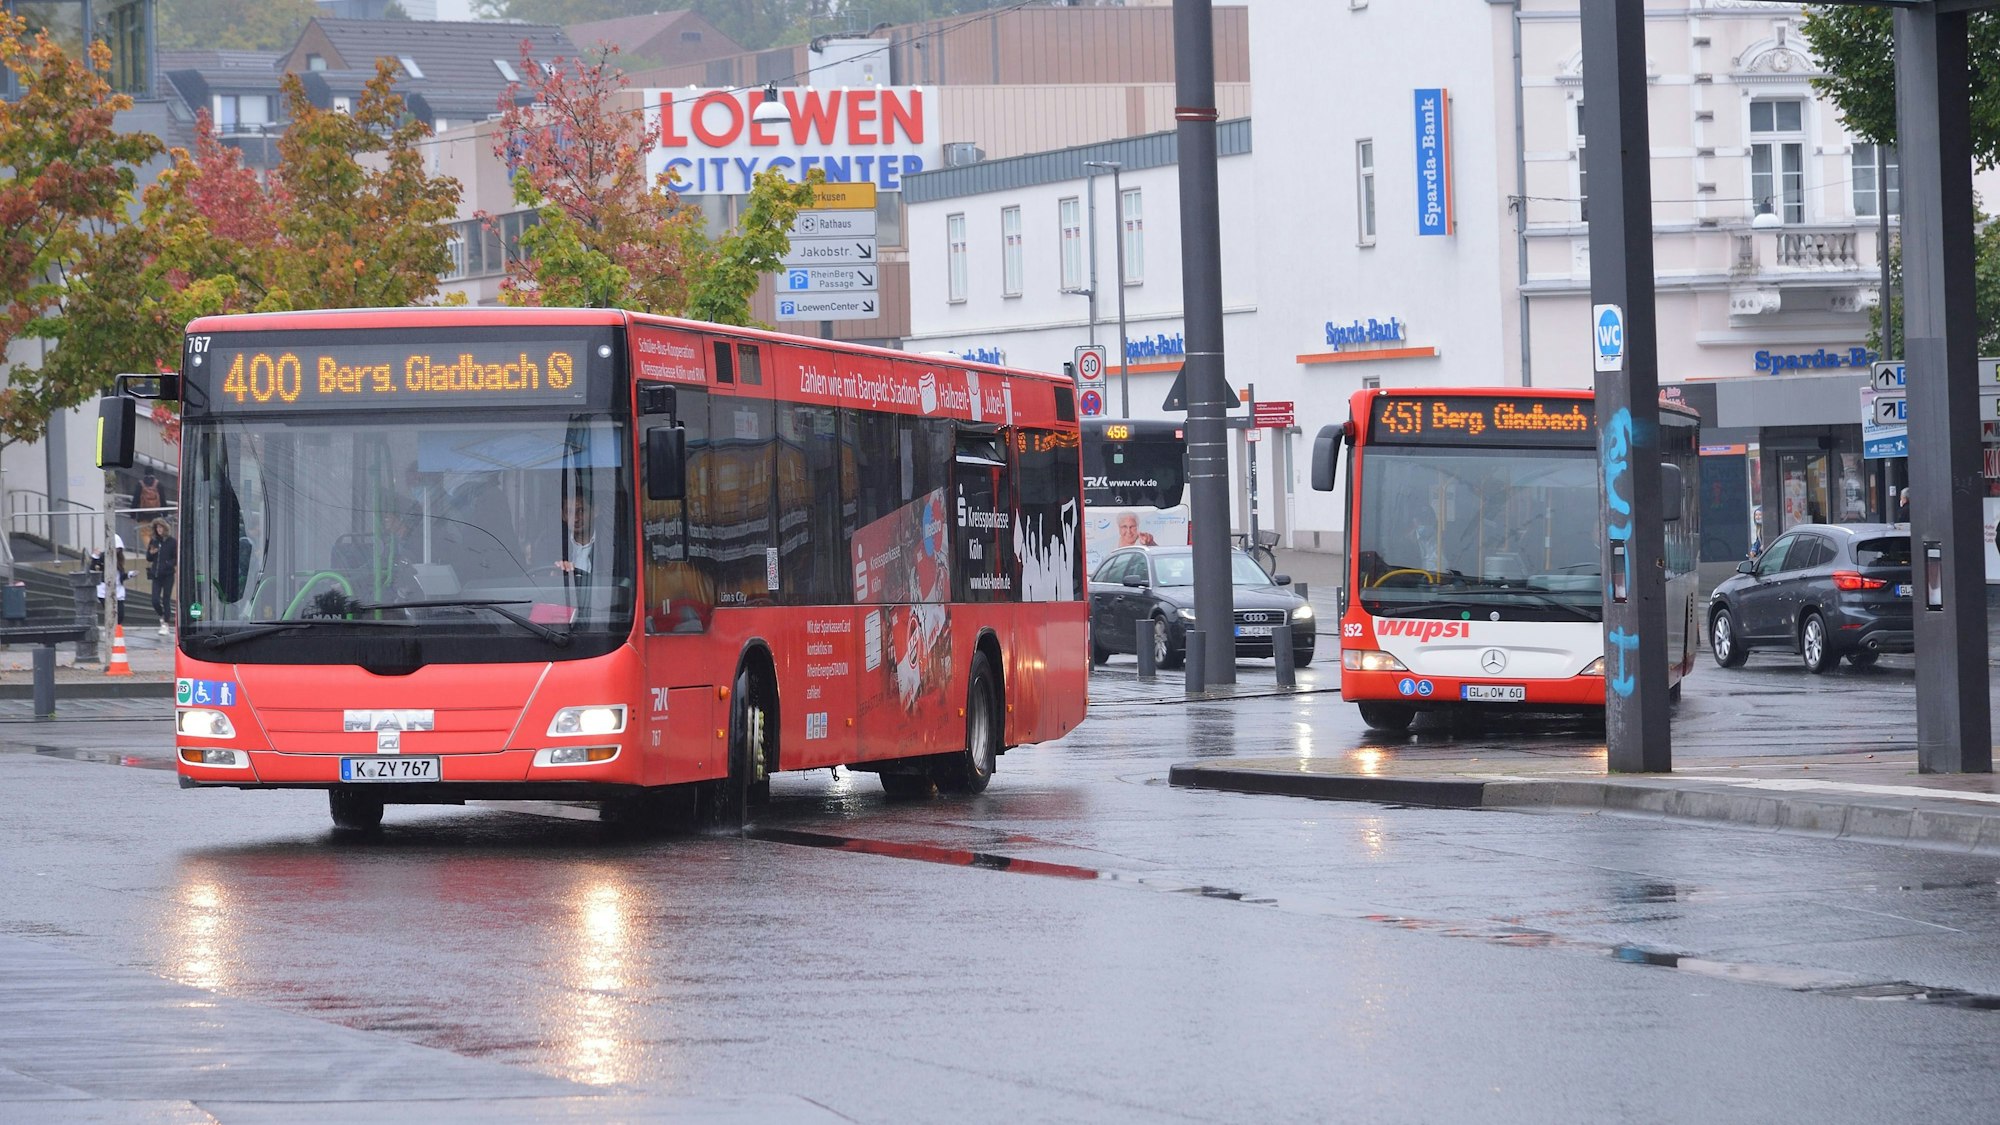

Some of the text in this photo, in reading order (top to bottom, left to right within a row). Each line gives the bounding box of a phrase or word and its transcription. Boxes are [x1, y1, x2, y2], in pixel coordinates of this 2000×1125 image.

[660, 90, 924, 147] LOEWEN
[1421, 98, 1442, 226] Sparda-Bank
[813, 192, 846, 202] erkusen
[820, 219, 852, 229] Rathaus
[800, 247, 853, 257] Jakobstr.
[811, 270, 854, 279] RheinBerg
[820, 280, 854, 289] Passage
[797, 302, 859, 312] LoewenCenter
[1325, 316, 1401, 351] Sparda-Bank
[1599, 325, 1620, 346] WC
[187, 336, 211, 354] 767
[638, 337, 695, 360] Schüler-Bus-Kooperation
[1125, 333, 1184, 364] parda-Bank
[1083, 359, 1097, 372] 30
[1754, 347, 1879, 375] Sparda-Ba
[223, 353, 302, 402] 400
[317, 356, 397, 393] Berg.
[405, 353, 539, 391] Gladbach
[640, 361, 706, 382] Kreissparkasse Köln und RVK
[799, 366, 828, 395] Zahlen
[828, 370, 842, 397] wie
[843, 372, 857, 399] mit
[857, 374, 889, 407] Bargeld:
[890, 379, 920, 406] Stadion-
[1381, 402, 1588, 434] 451 Berg. Gladbach
[1107, 425, 1128, 439] 456
[1108, 479, 1158, 487] www.rvk.de
[968, 506, 1009, 534] Kreissparkasse
[969, 537, 983, 560] Köln
[870, 545, 901, 571] Kreissparkasse
[872, 576, 881, 594] Köln
[1344, 623, 1363, 637] 352
[1469, 686, 1522, 698] GL OW 60
[652, 730, 661, 746] 767
[356, 761, 430, 777] K ZY 767
